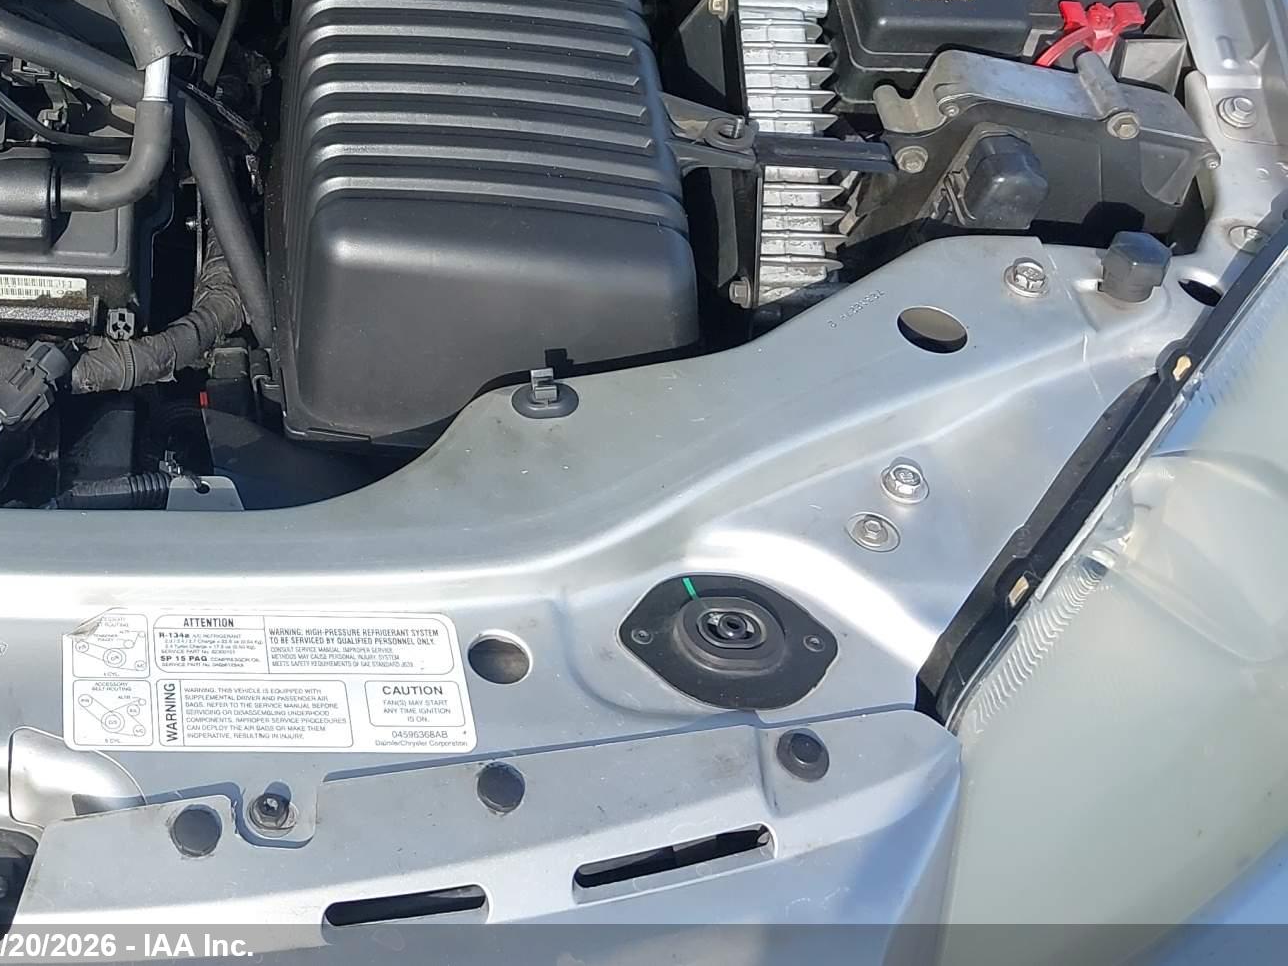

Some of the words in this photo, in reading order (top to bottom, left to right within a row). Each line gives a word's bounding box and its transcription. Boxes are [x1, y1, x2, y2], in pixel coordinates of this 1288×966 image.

[184, 618, 234, 628] ATTENTION
[306, 629, 361, 637] HIGH-PRESSURE
[291, 637, 325, 645] SERVICED
[383, 686, 443, 695] CAUTION
[164, 683, 179, 742] WARNING
[429, 740, 468, 748] Corporation
